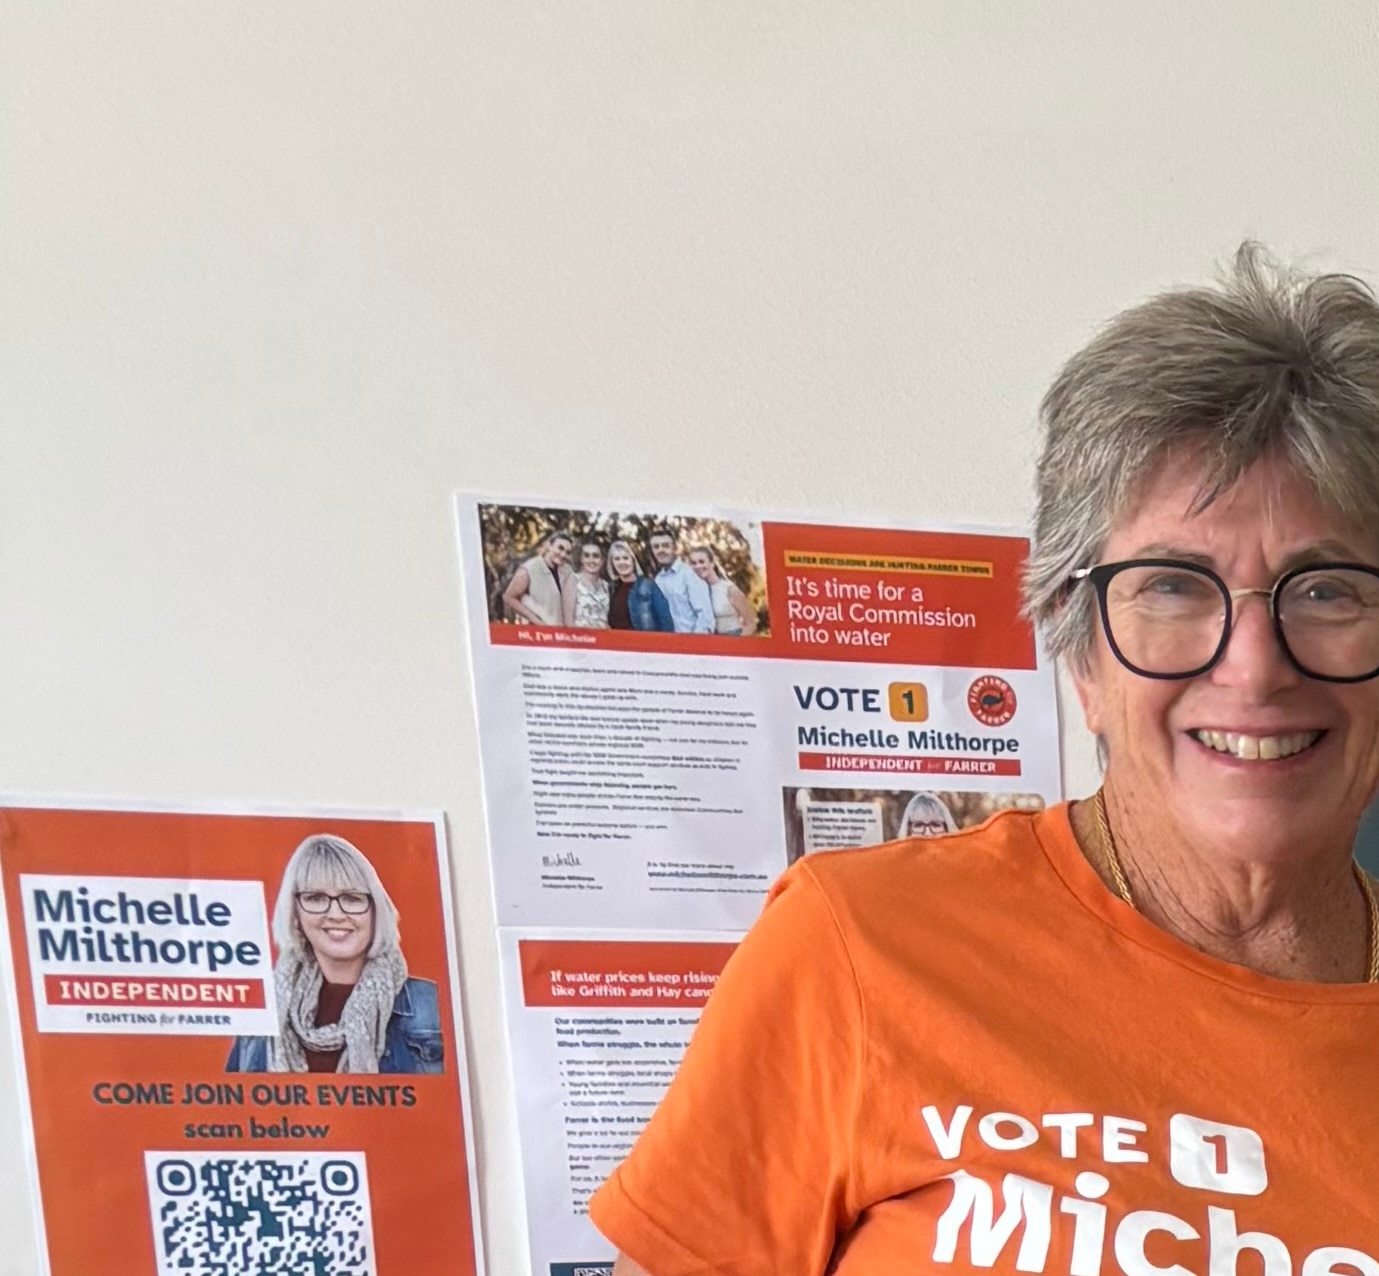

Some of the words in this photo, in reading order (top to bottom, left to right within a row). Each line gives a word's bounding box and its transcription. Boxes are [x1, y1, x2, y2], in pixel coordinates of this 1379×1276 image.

[786, 576, 819, 597] It's
[824, 577, 871, 600] time
[877, 580, 905, 601] for
[911, 587, 923, 602] a
[788, 600, 843, 625] Royal
[849, 603, 976, 628] Commission
[790, 622, 829, 644] into
[834, 628, 891, 647] water
[793, 685, 881, 713] VOTE
[902, 690, 915, 714] 1
[798, 726, 899, 748] Michelle
[908, 729, 1019, 756] Milthorpe
[825, 756, 922, 772] INDEPENDENT
[944, 760, 996, 773] FARRER
[33, 886, 232, 927] Michelle
[38, 926, 262, 972] Milthorpe
[564, 971, 602, 983] water
[605, 970, 646, 984] prices
[648, 972, 681, 985] keep
[59, 980, 250, 1003] INDEPENDENT
[551, 985, 576, 997] like
[629, 986, 652, 998] and
[656, 987, 682, 999] Hay
[86, 1012, 157, 1025] FIGHTING
[92, 1082, 173, 1105] COME
[181, 1083, 244, 1106] JOIN
[251, 1083, 311, 1107] OUR
[317, 1085, 418, 1107] EVENTS
[184, 1121, 244, 1140] scan
[249, 1116, 331, 1140] below
[921, 1104, 1149, 1163] VOTE
[1202, 1133, 1229, 1175] 1
